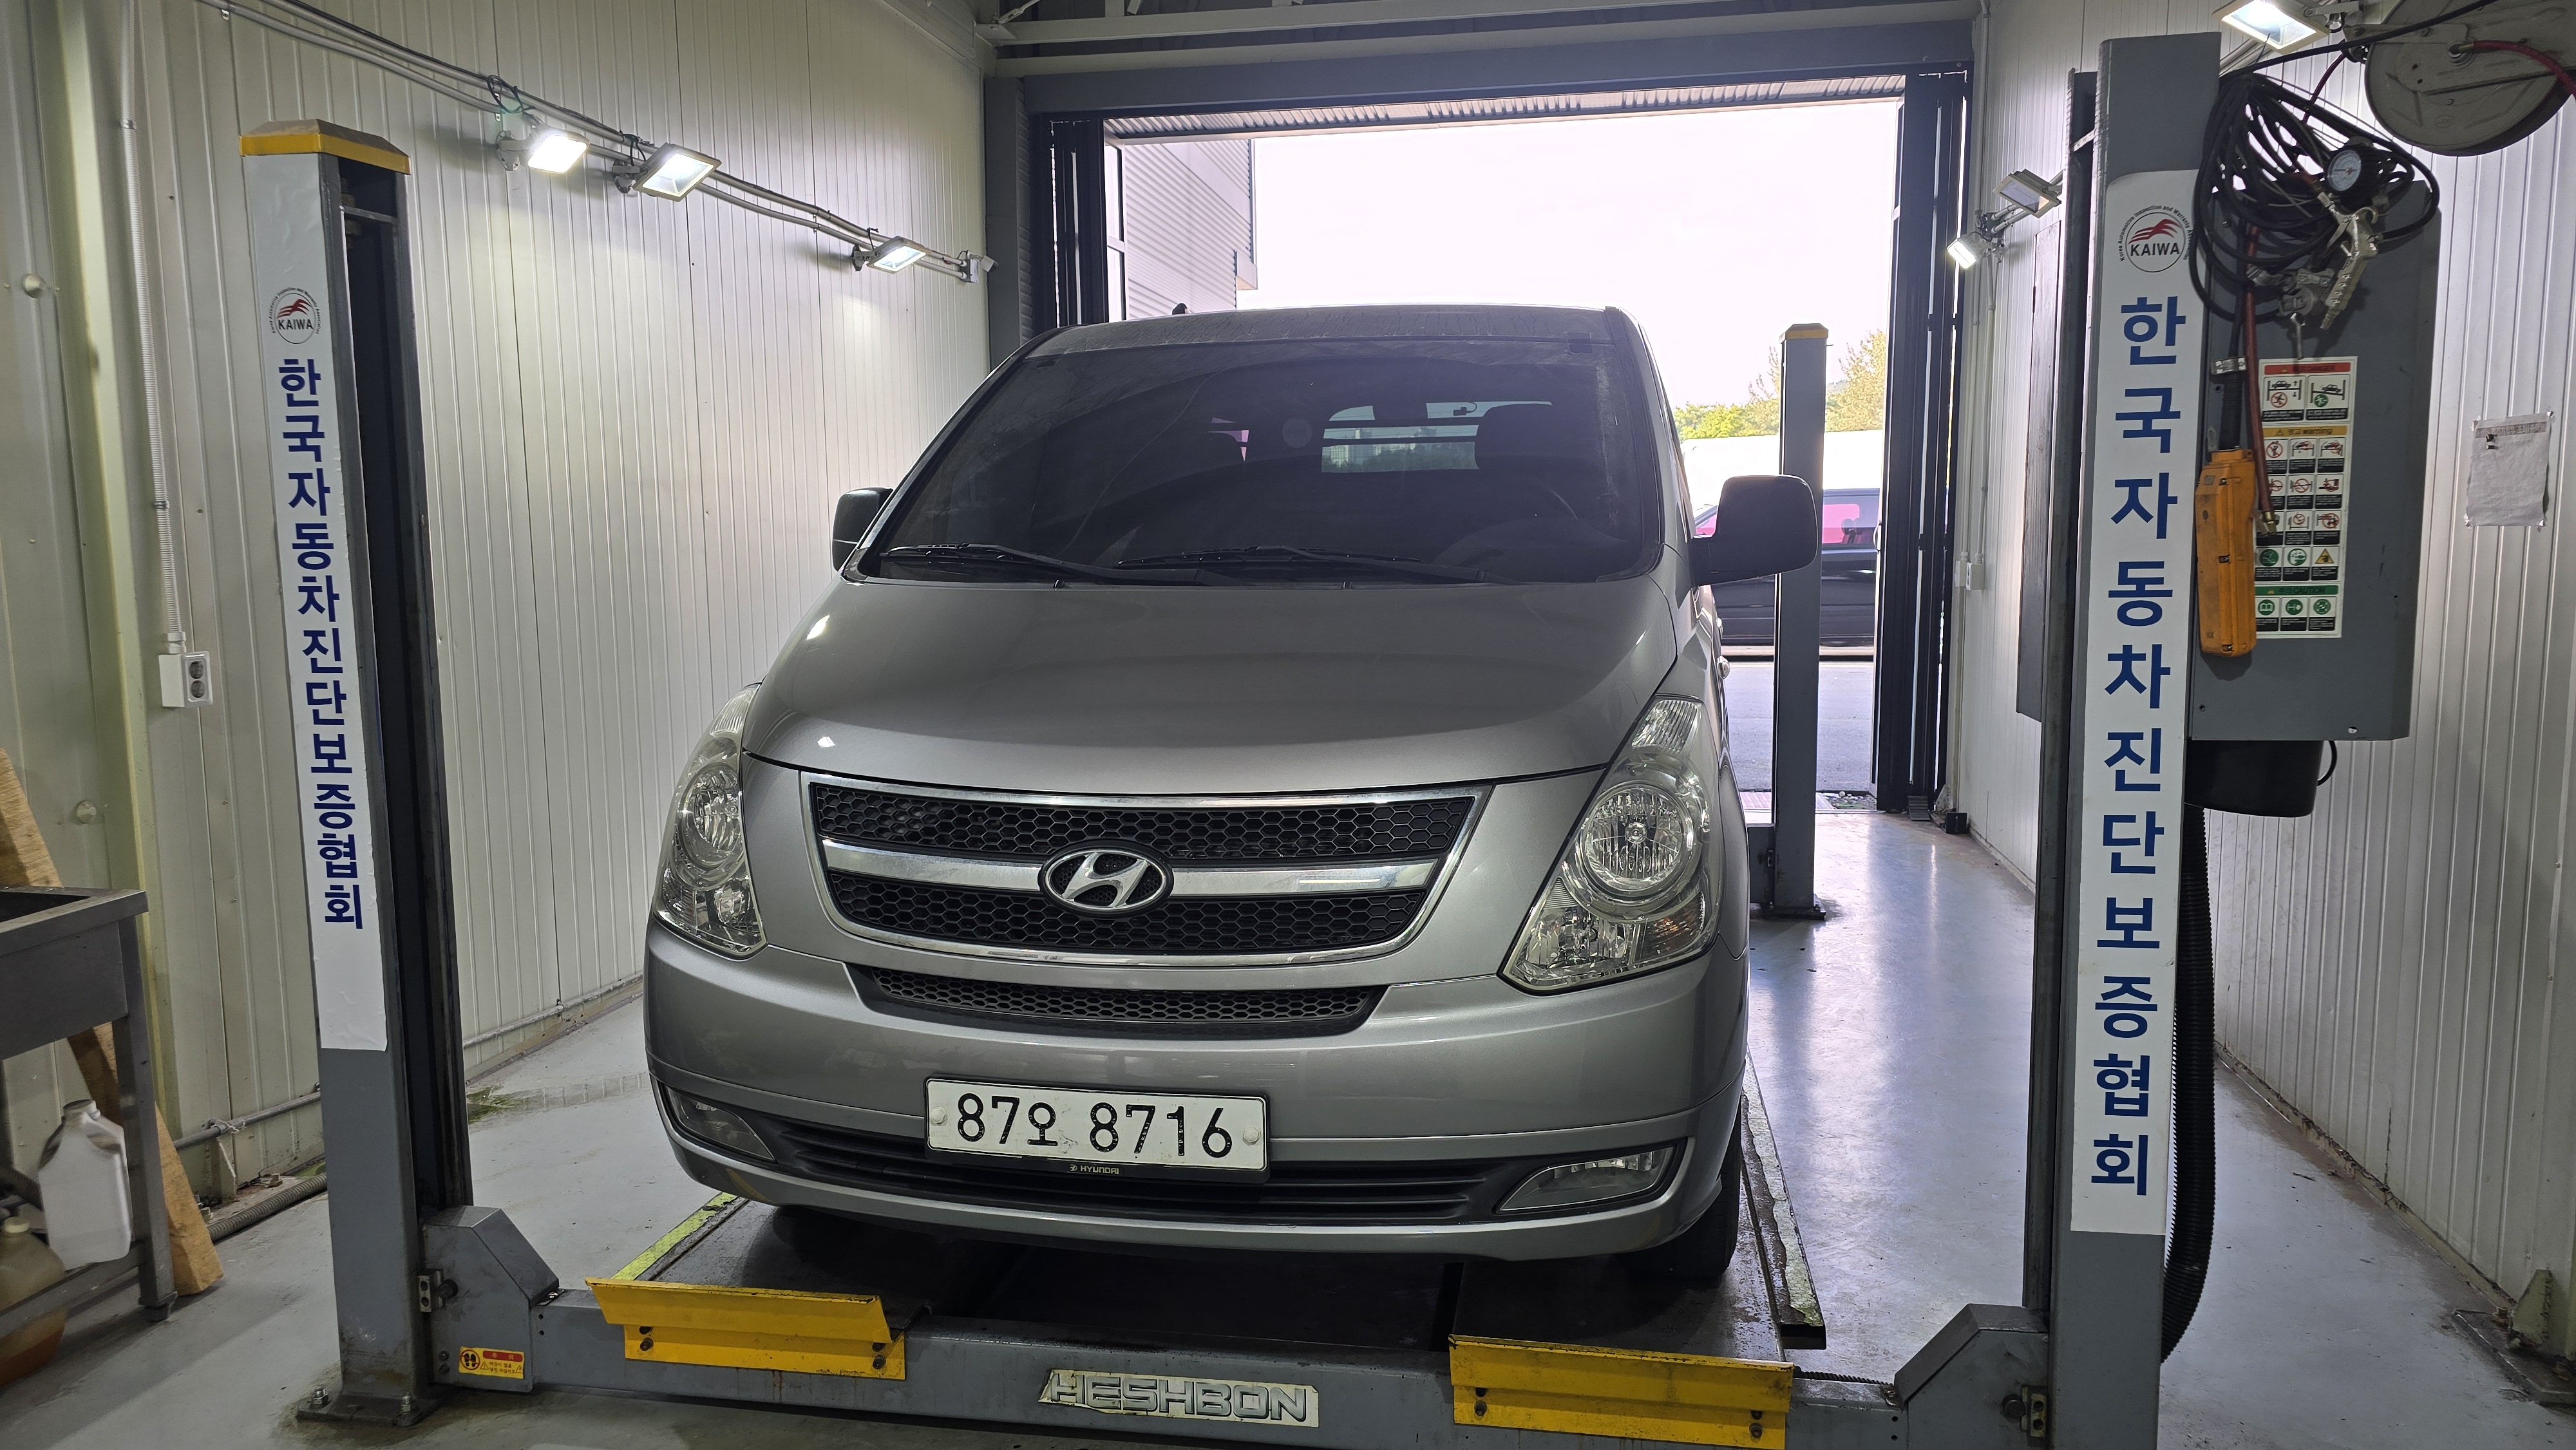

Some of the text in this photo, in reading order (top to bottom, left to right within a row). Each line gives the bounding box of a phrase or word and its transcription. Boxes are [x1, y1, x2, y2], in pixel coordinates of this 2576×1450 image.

[2130, 243, 2180, 256] KAIWA
[278, 319, 314, 330] KAIWA
[279, 359, 362, 930] 한국자동차진단보증협회
[2091, 295, 2185, 1196] 한국자동차진단보증협회
[958, 1093, 1233, 1158] 87오 8716
[1080, 1165, 1119, 1174] HYUNDAI
[1049, 1373, 1307, 1422] HESHBON
